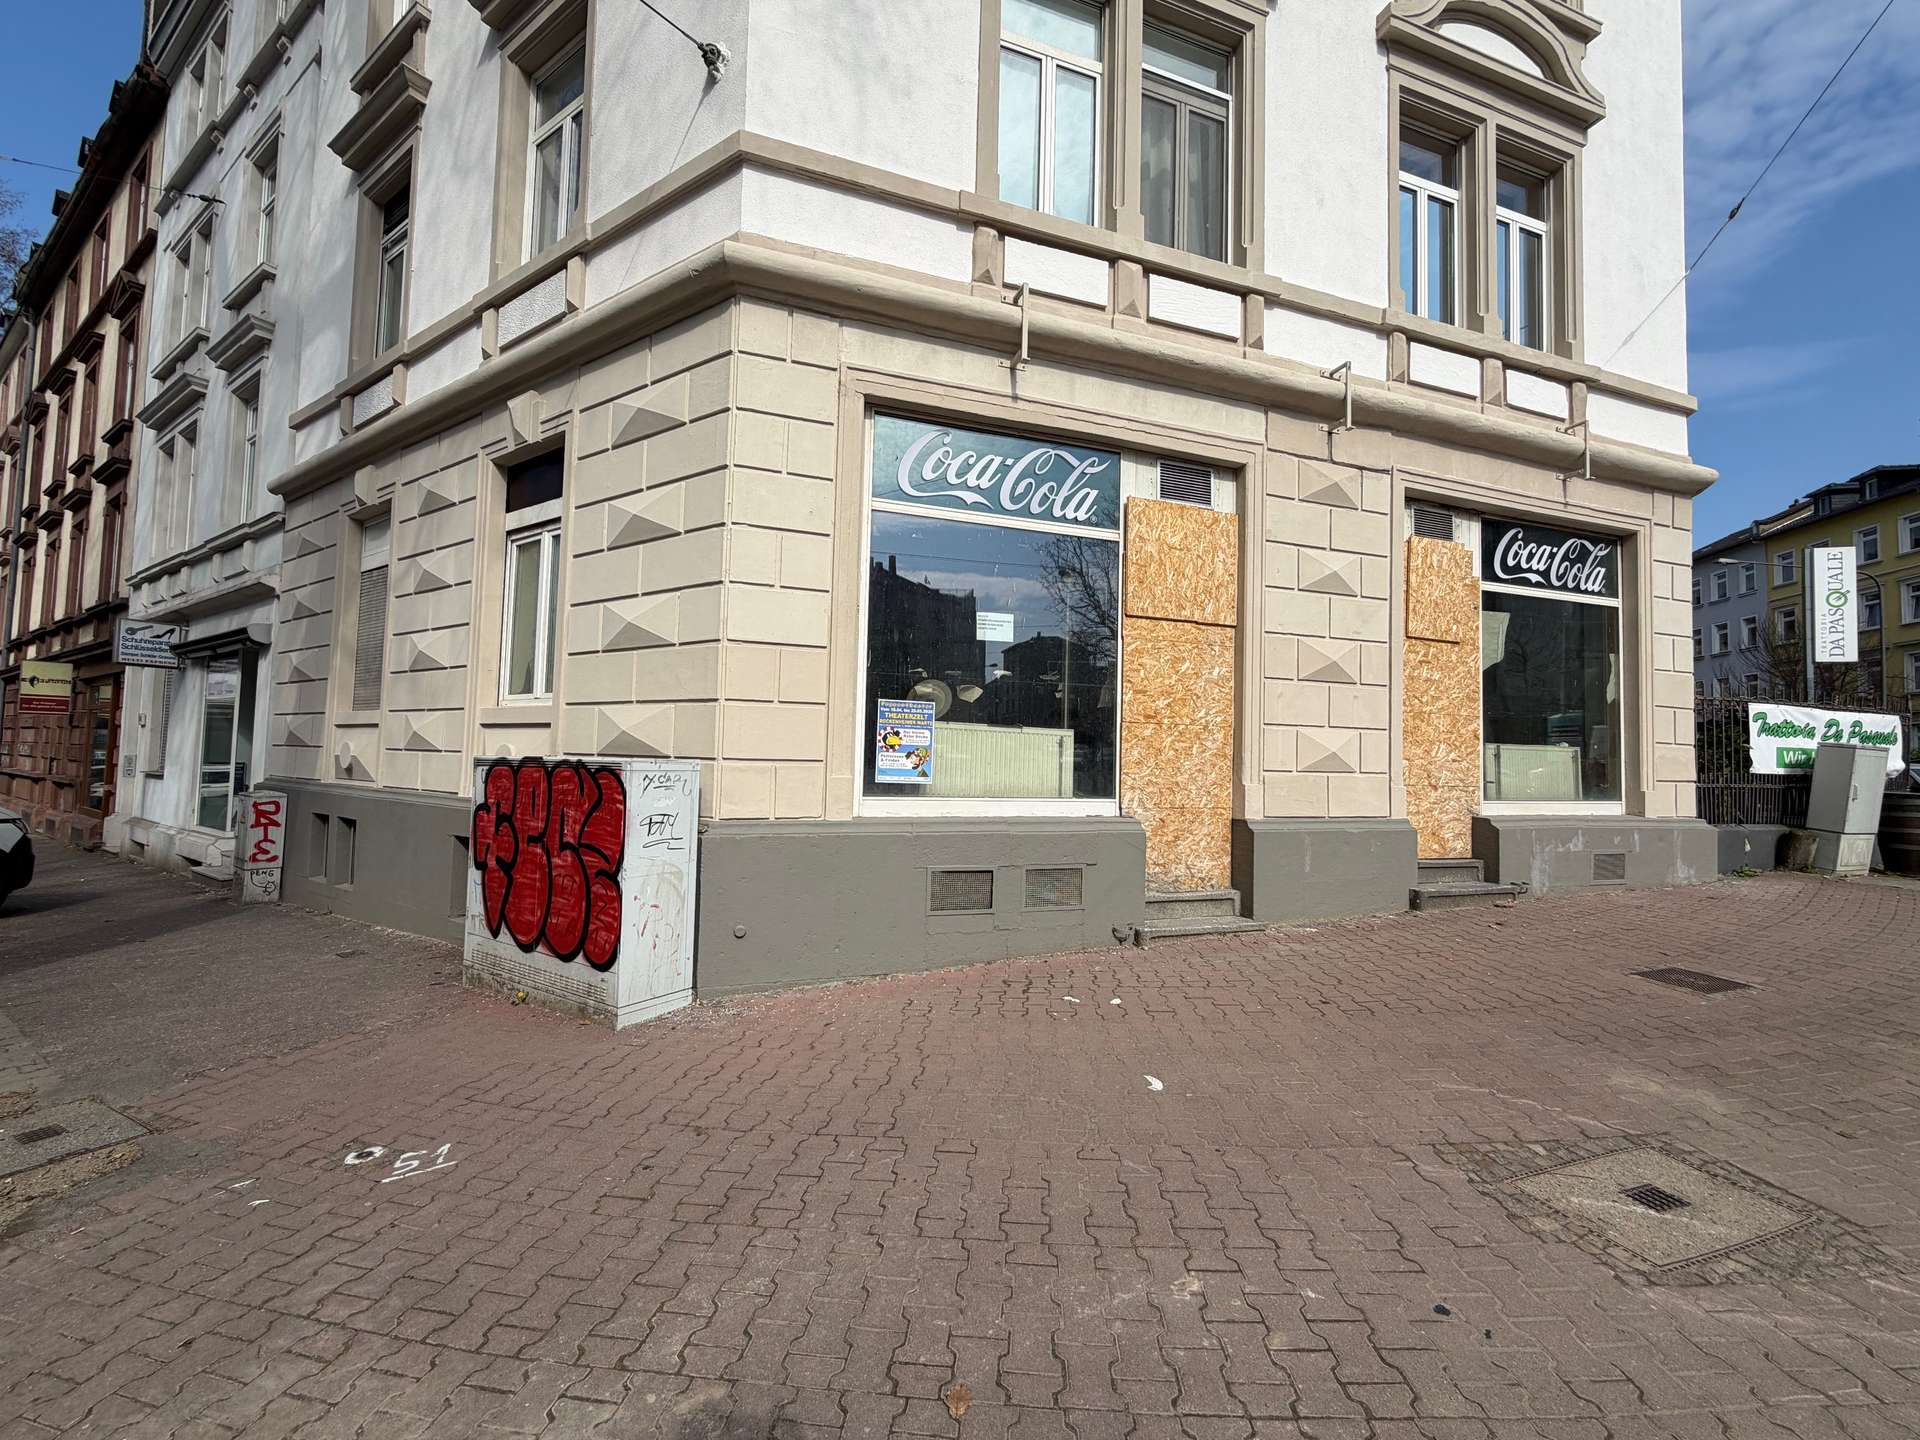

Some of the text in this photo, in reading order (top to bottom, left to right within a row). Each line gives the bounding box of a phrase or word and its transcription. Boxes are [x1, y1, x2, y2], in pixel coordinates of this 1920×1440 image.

[897, 429, 1112, 522] Coca-Cola
[1493, 527, 1613, 593] Coca-Cola
[885, 712, 929, 720] THEATERZELT
[1820, 718, 1844, 743] Da
[1783, 750, 1807, 764] Wir
[391, 1143, 452, 1176] 51
